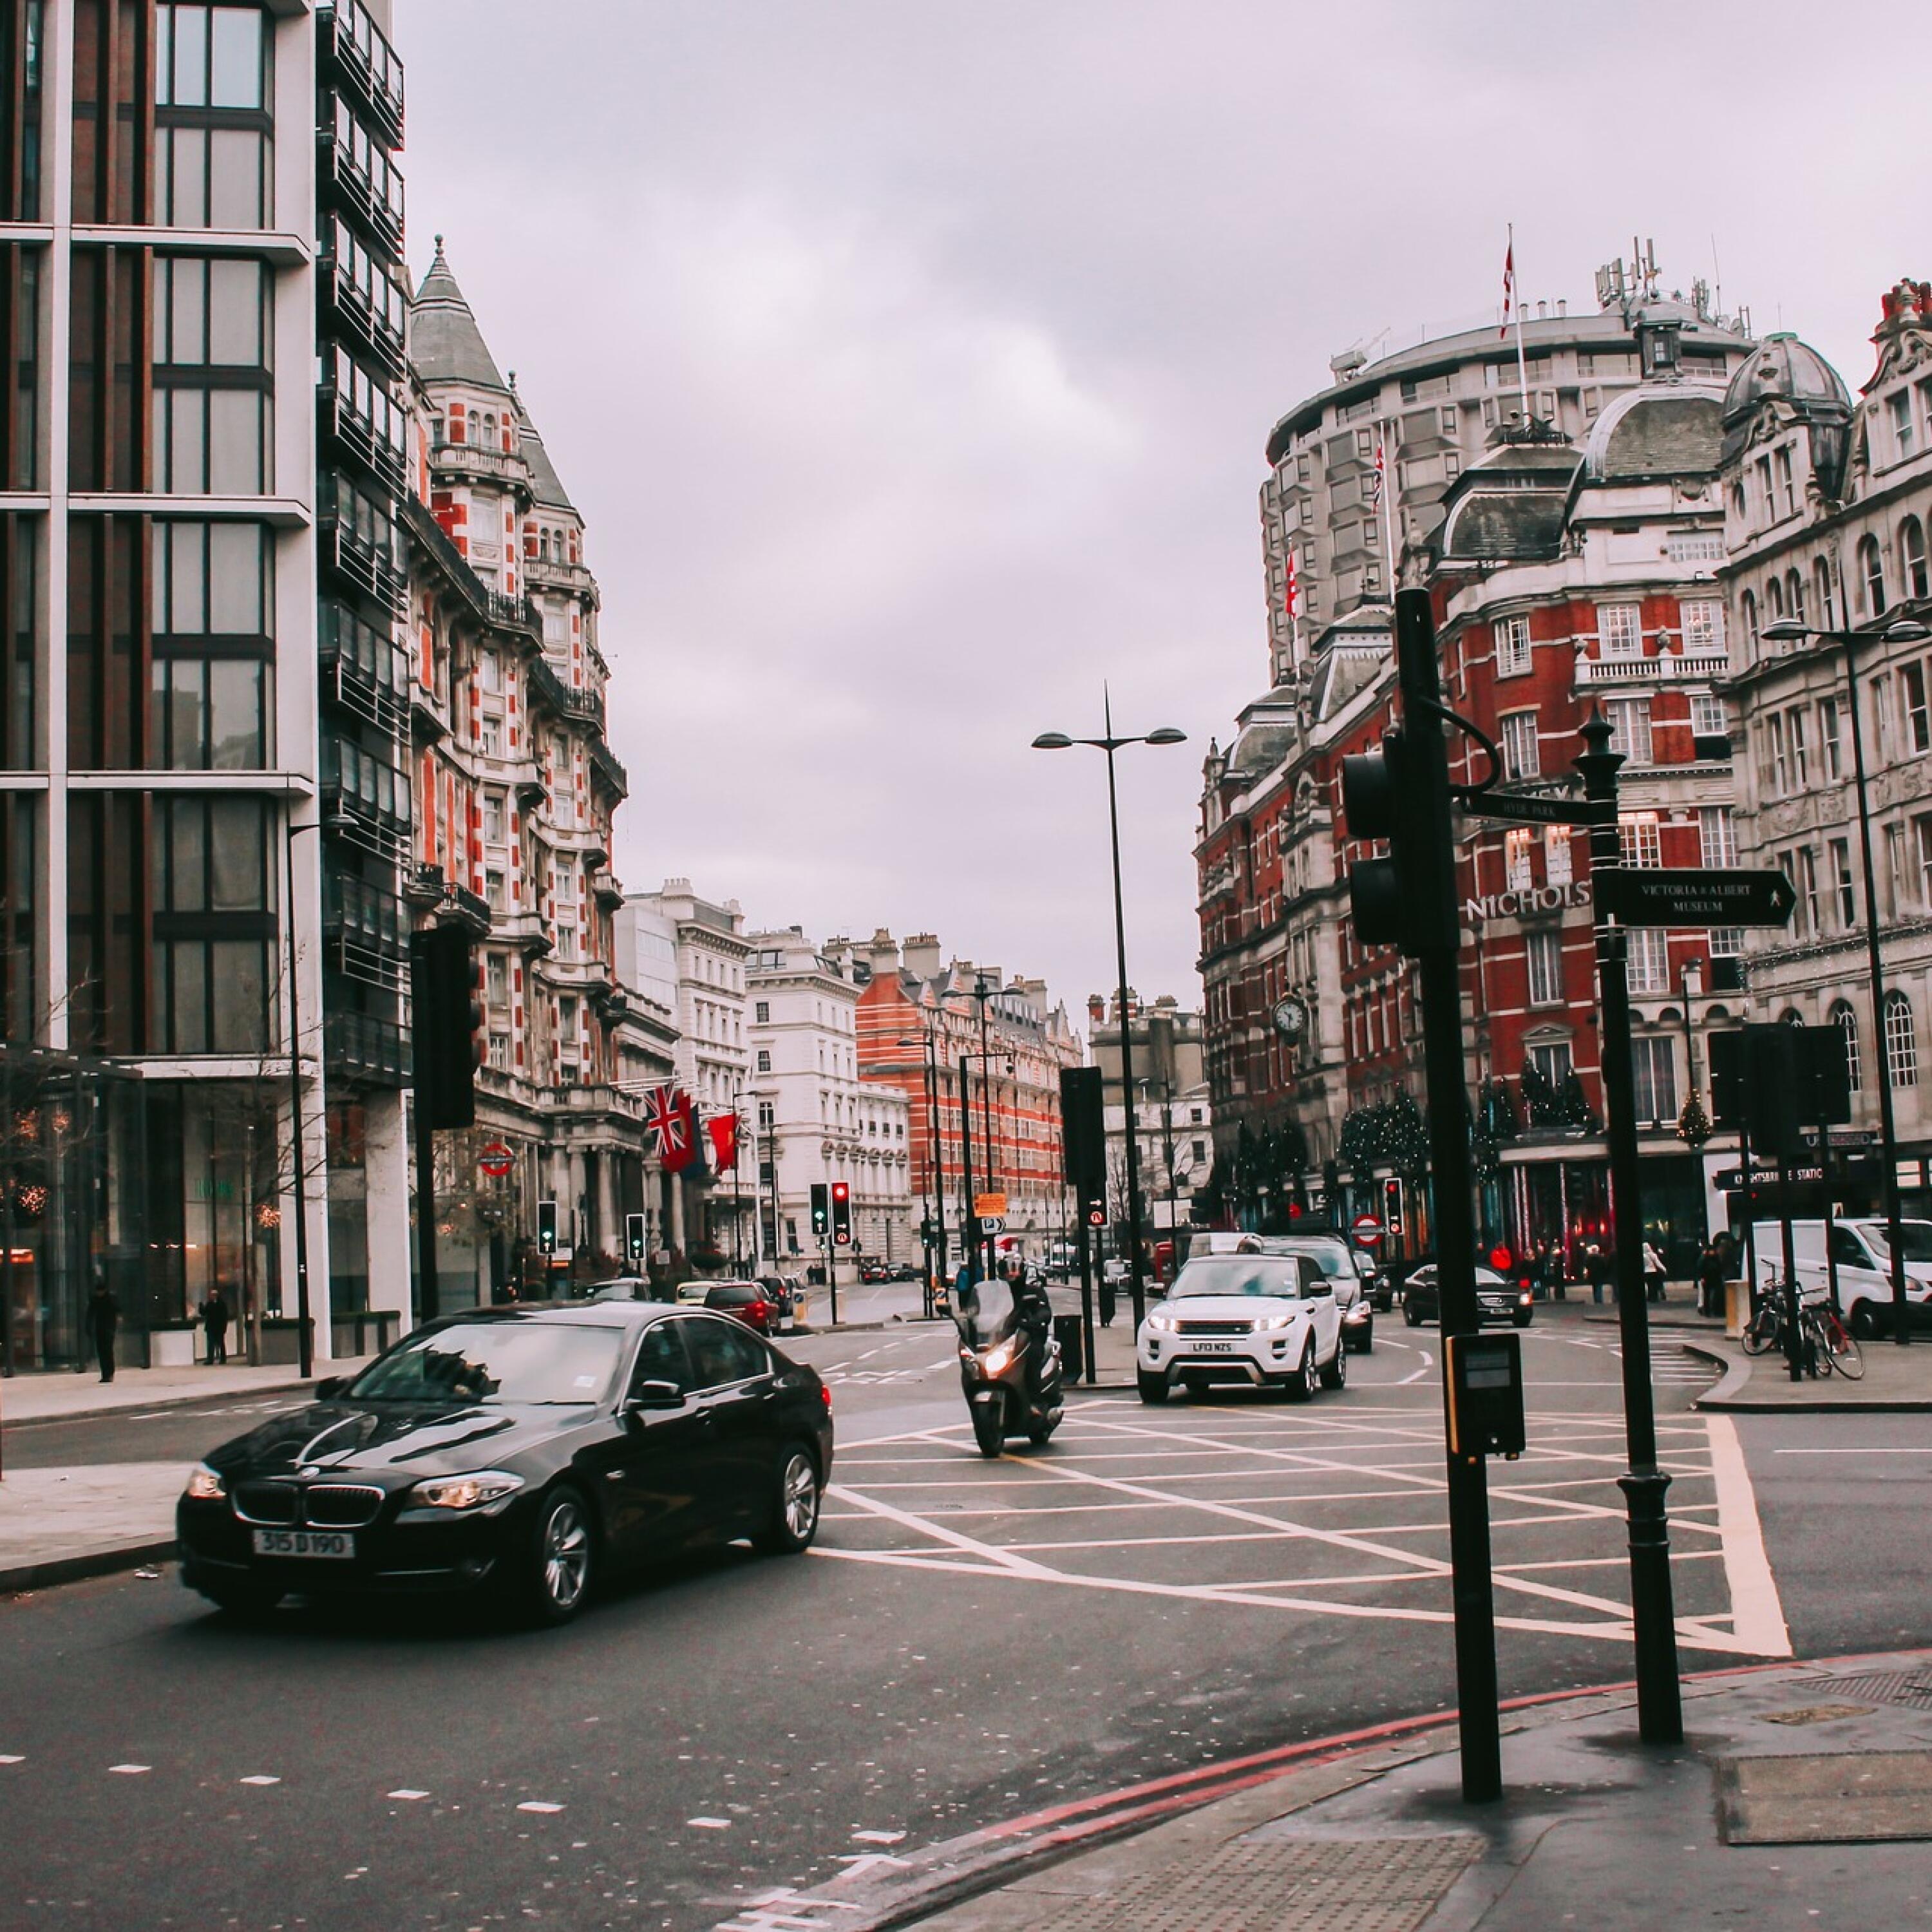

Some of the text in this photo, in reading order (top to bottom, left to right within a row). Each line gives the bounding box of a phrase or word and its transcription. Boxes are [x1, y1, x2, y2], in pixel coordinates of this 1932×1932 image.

[1642, 884, 1697, 895] VICTORIA
[1709, 884, 1750, 895] ALBERT
[1466, 879, 1591, 922] NICHOLS
[1674, 901, 1723, 912] MUSEUM
